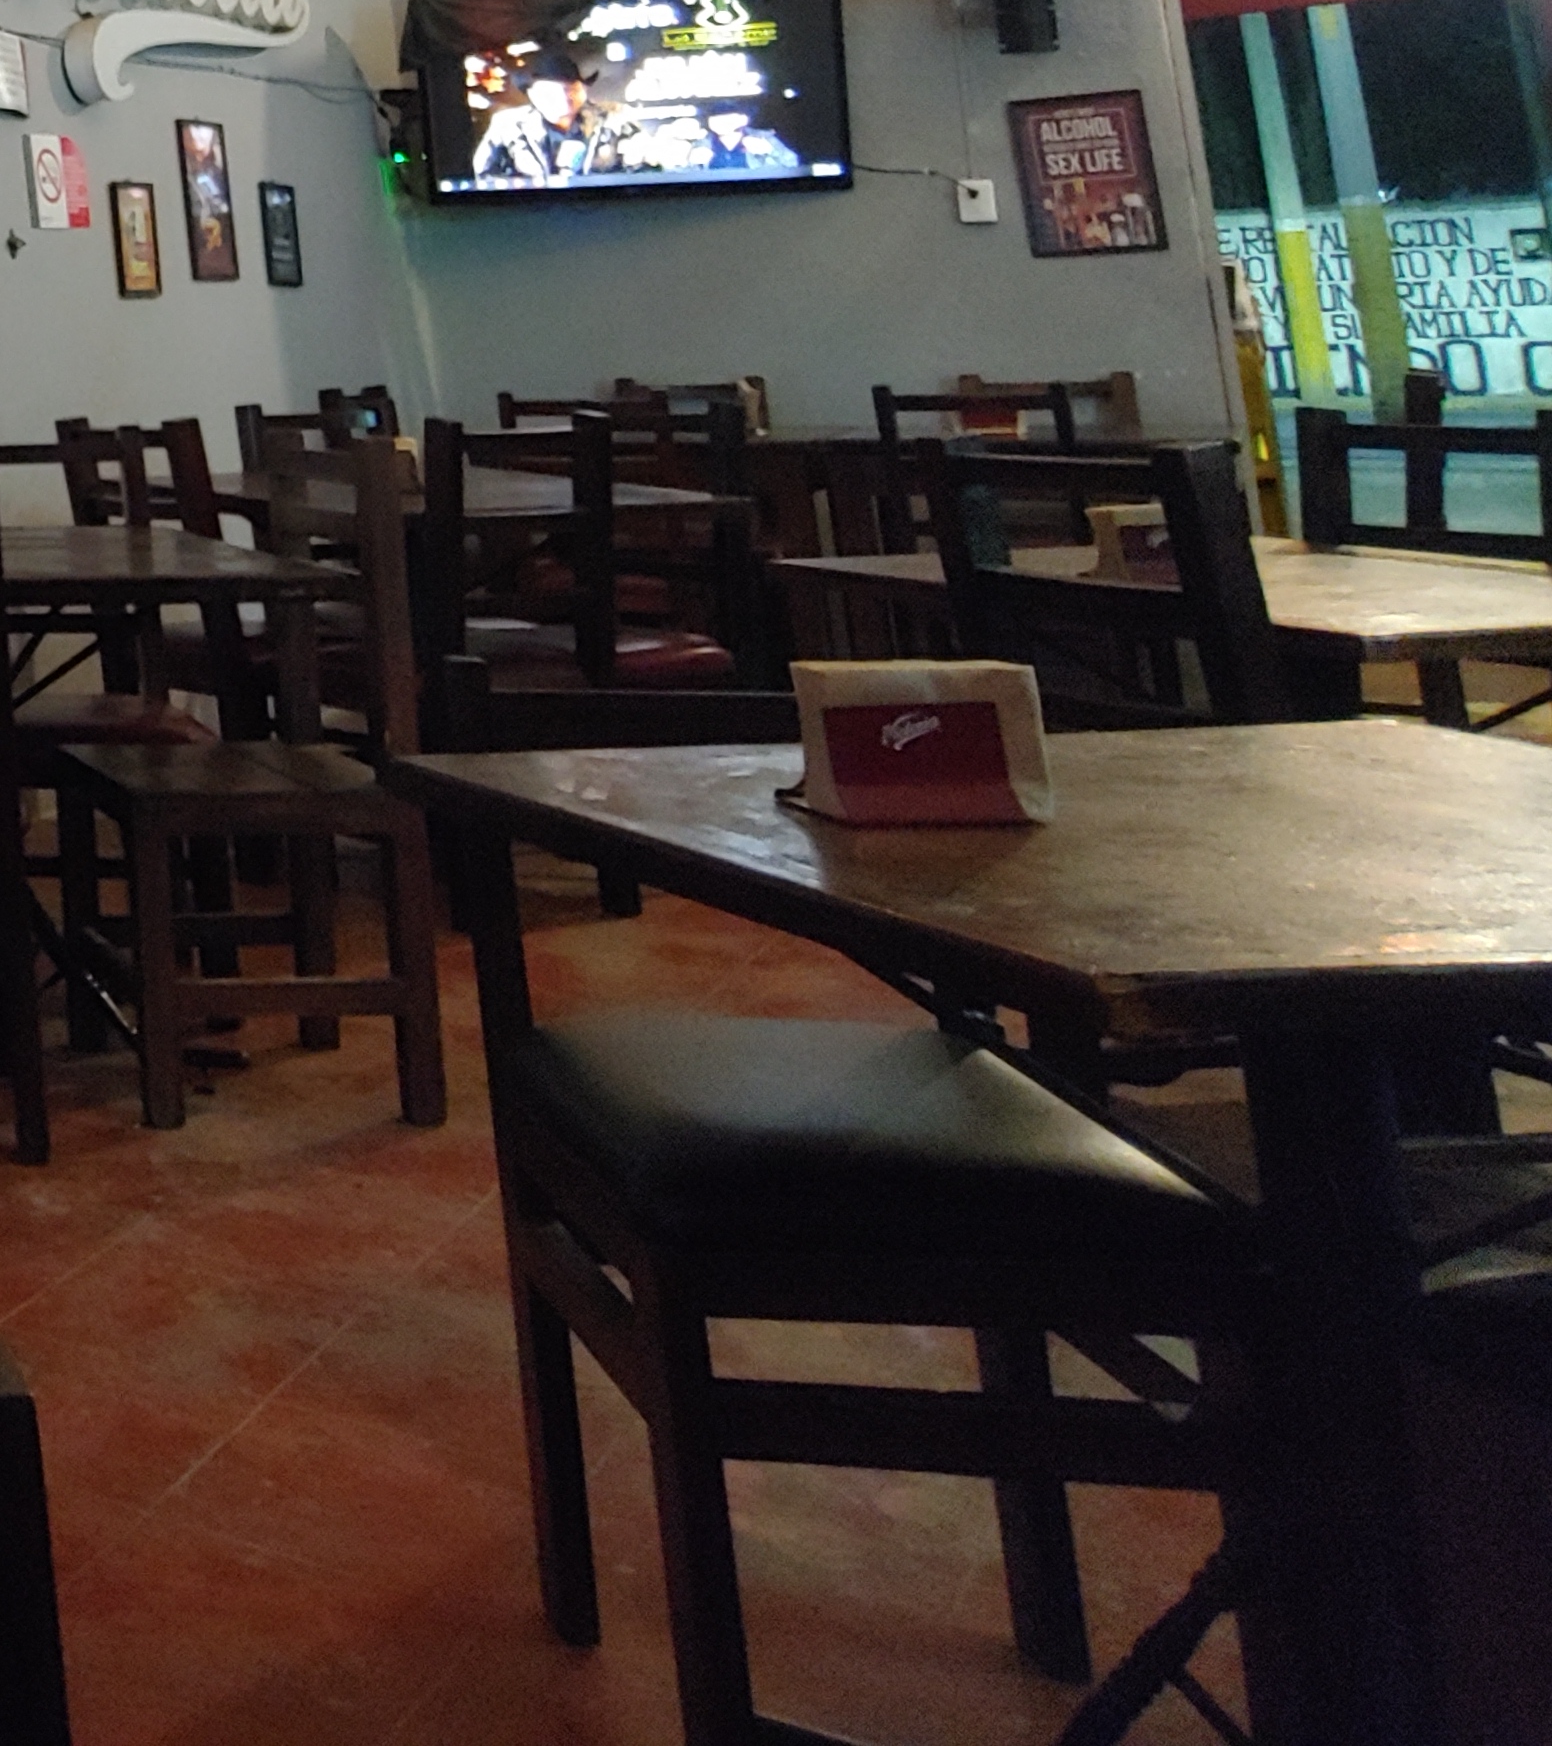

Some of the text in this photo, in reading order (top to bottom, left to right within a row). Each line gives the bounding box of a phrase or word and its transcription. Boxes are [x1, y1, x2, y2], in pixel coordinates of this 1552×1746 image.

[1040, 116, 1118, 143] ALCOHOL
[1045, 148, 1124, 175] SEX LIFE
[1435, 248, 1457, 277] Y
[1467, 247, 1514, 276] DE
[1405, 310, 1528, 339] AMILIA
